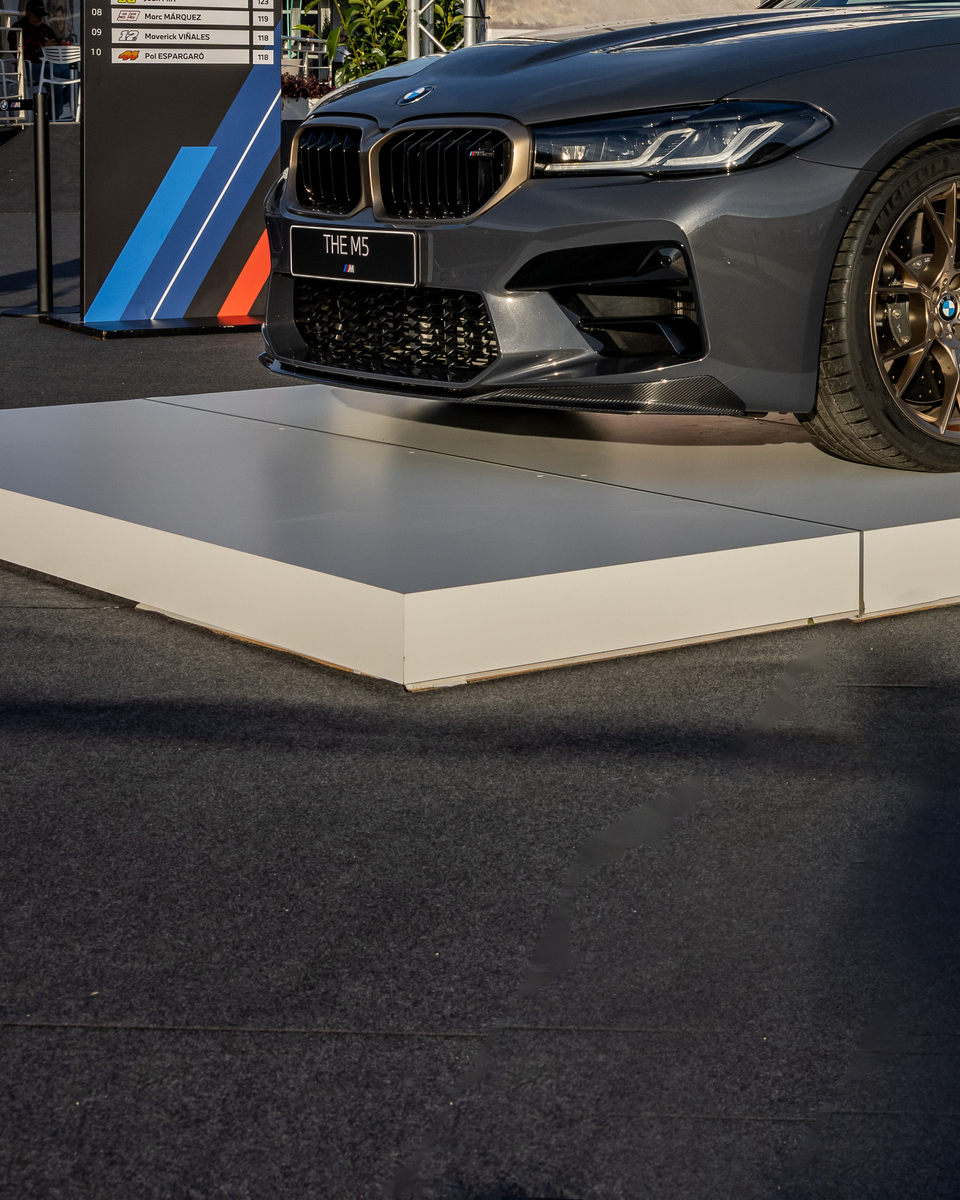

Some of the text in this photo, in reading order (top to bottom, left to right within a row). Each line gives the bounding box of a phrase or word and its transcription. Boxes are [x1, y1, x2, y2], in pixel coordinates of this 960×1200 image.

[91, 8, 103, 17] 08
[144, 12, 163, 21] Marc
[163, 12, 202, 22] MÁRQUEZ
[257, 15, 269, 23] 119
[91, 28, 102, 36] 09
[144, 31, 177, 41] Maverick
[178, 32, 210, 41] VIÑALES
[257, 34, 270, 42] 118
[91, 48, 102, 56] 10
[144, 52, 157, 60] Pol
[158, 52, 205, 61] ESPARGARÓ
[322, 234, 369, 256] THE M5
